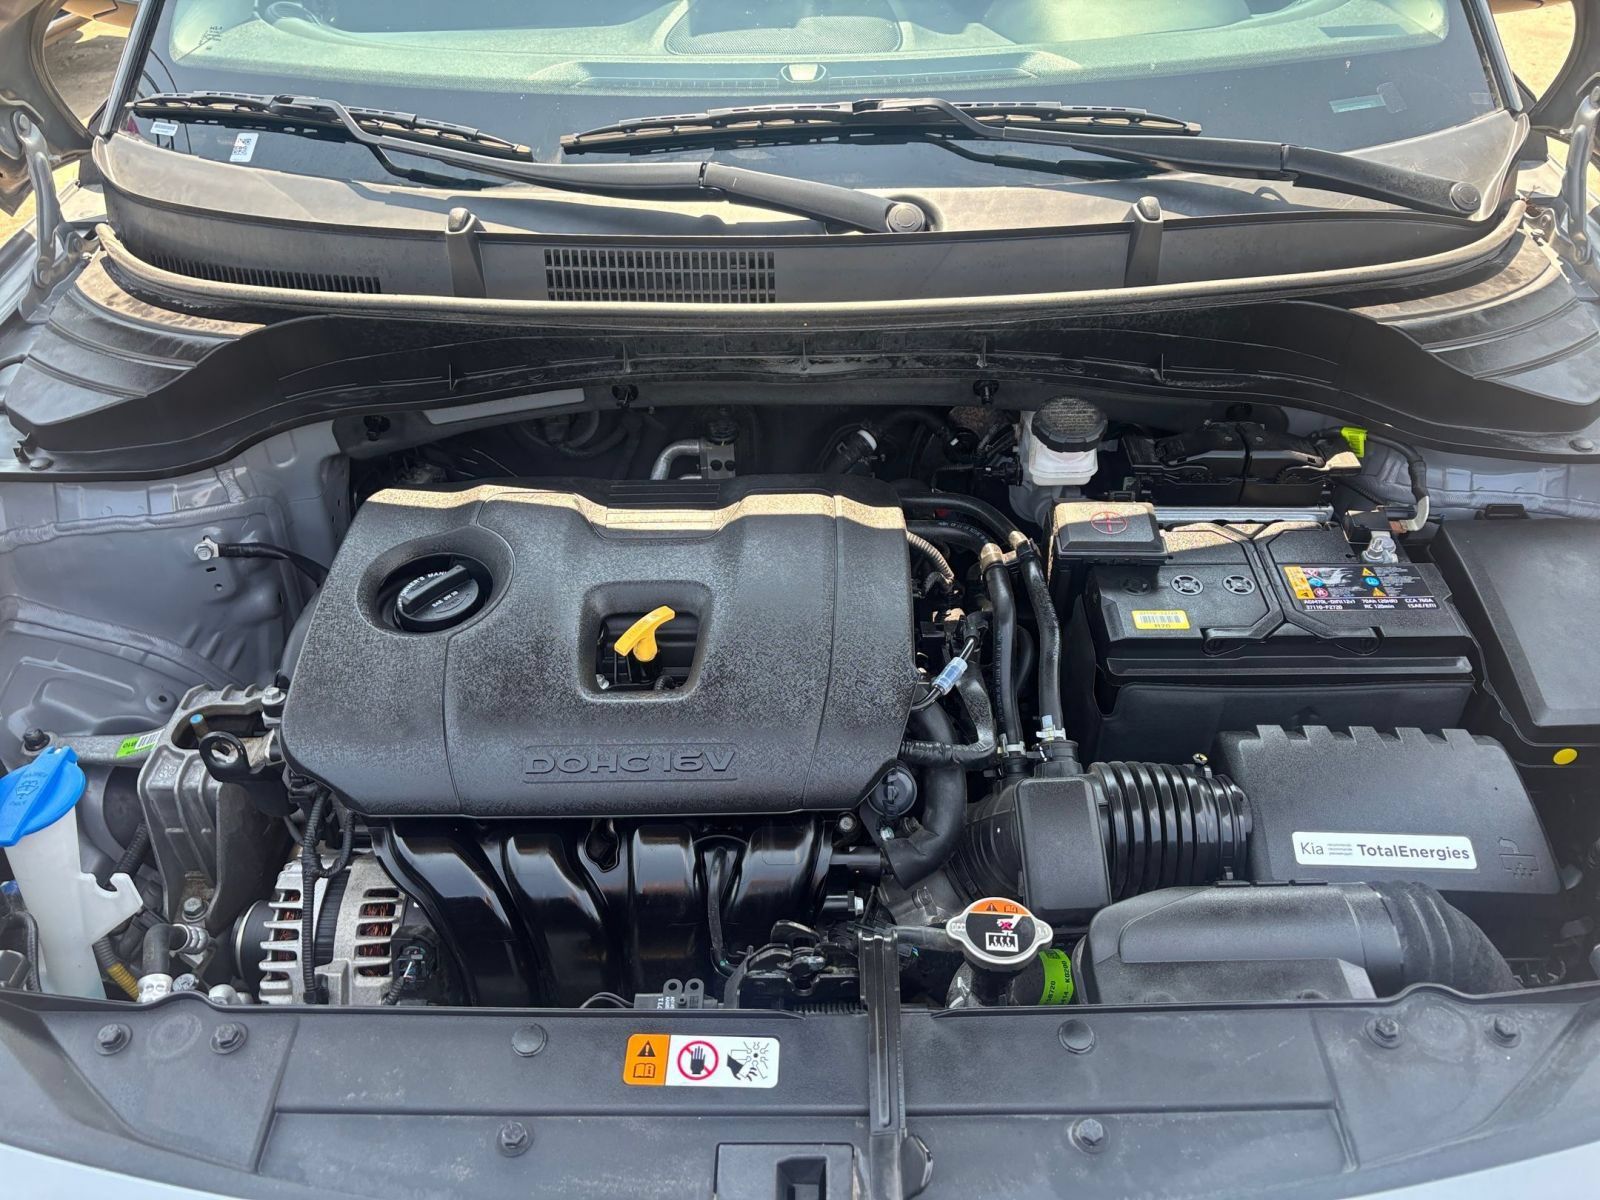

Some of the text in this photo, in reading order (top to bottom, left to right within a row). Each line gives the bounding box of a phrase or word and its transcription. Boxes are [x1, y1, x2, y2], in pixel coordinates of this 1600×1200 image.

[525, 750, 736, 775] DOHC 16V
[1300, 842, 1324, 855] Kia
[1357, 844, 1470, 861] TotalEnergies
